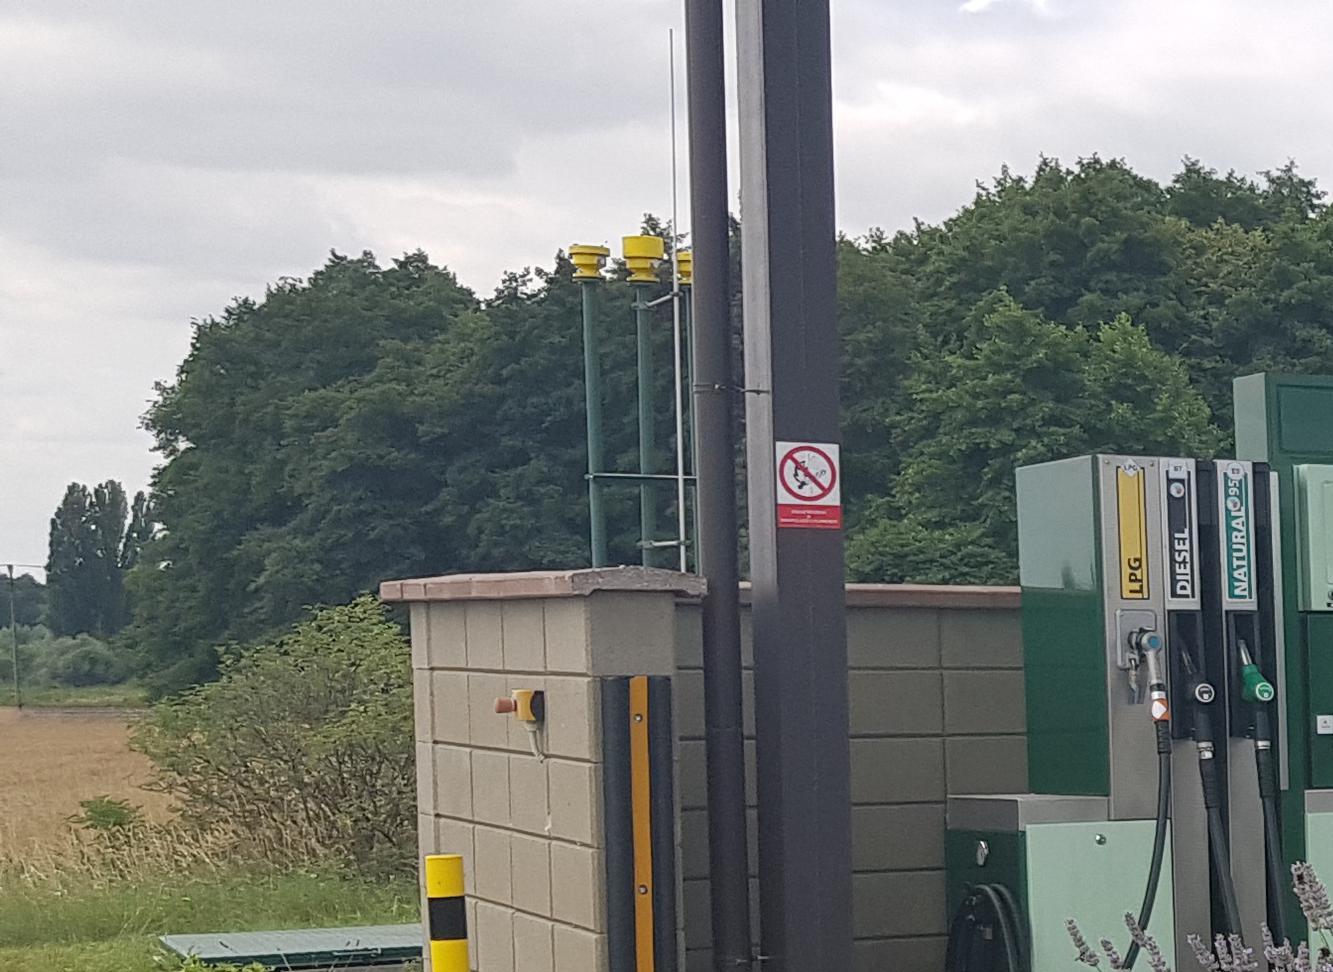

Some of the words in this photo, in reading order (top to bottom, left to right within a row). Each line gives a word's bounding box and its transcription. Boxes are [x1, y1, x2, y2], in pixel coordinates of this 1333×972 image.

[1228, 479, 1240, 495] 95
[1128, 557, 1144, 595] LPG
[1174, 528, 1191, 596] DIESEL
[1230, 506, 1248, 597] NATURAL
